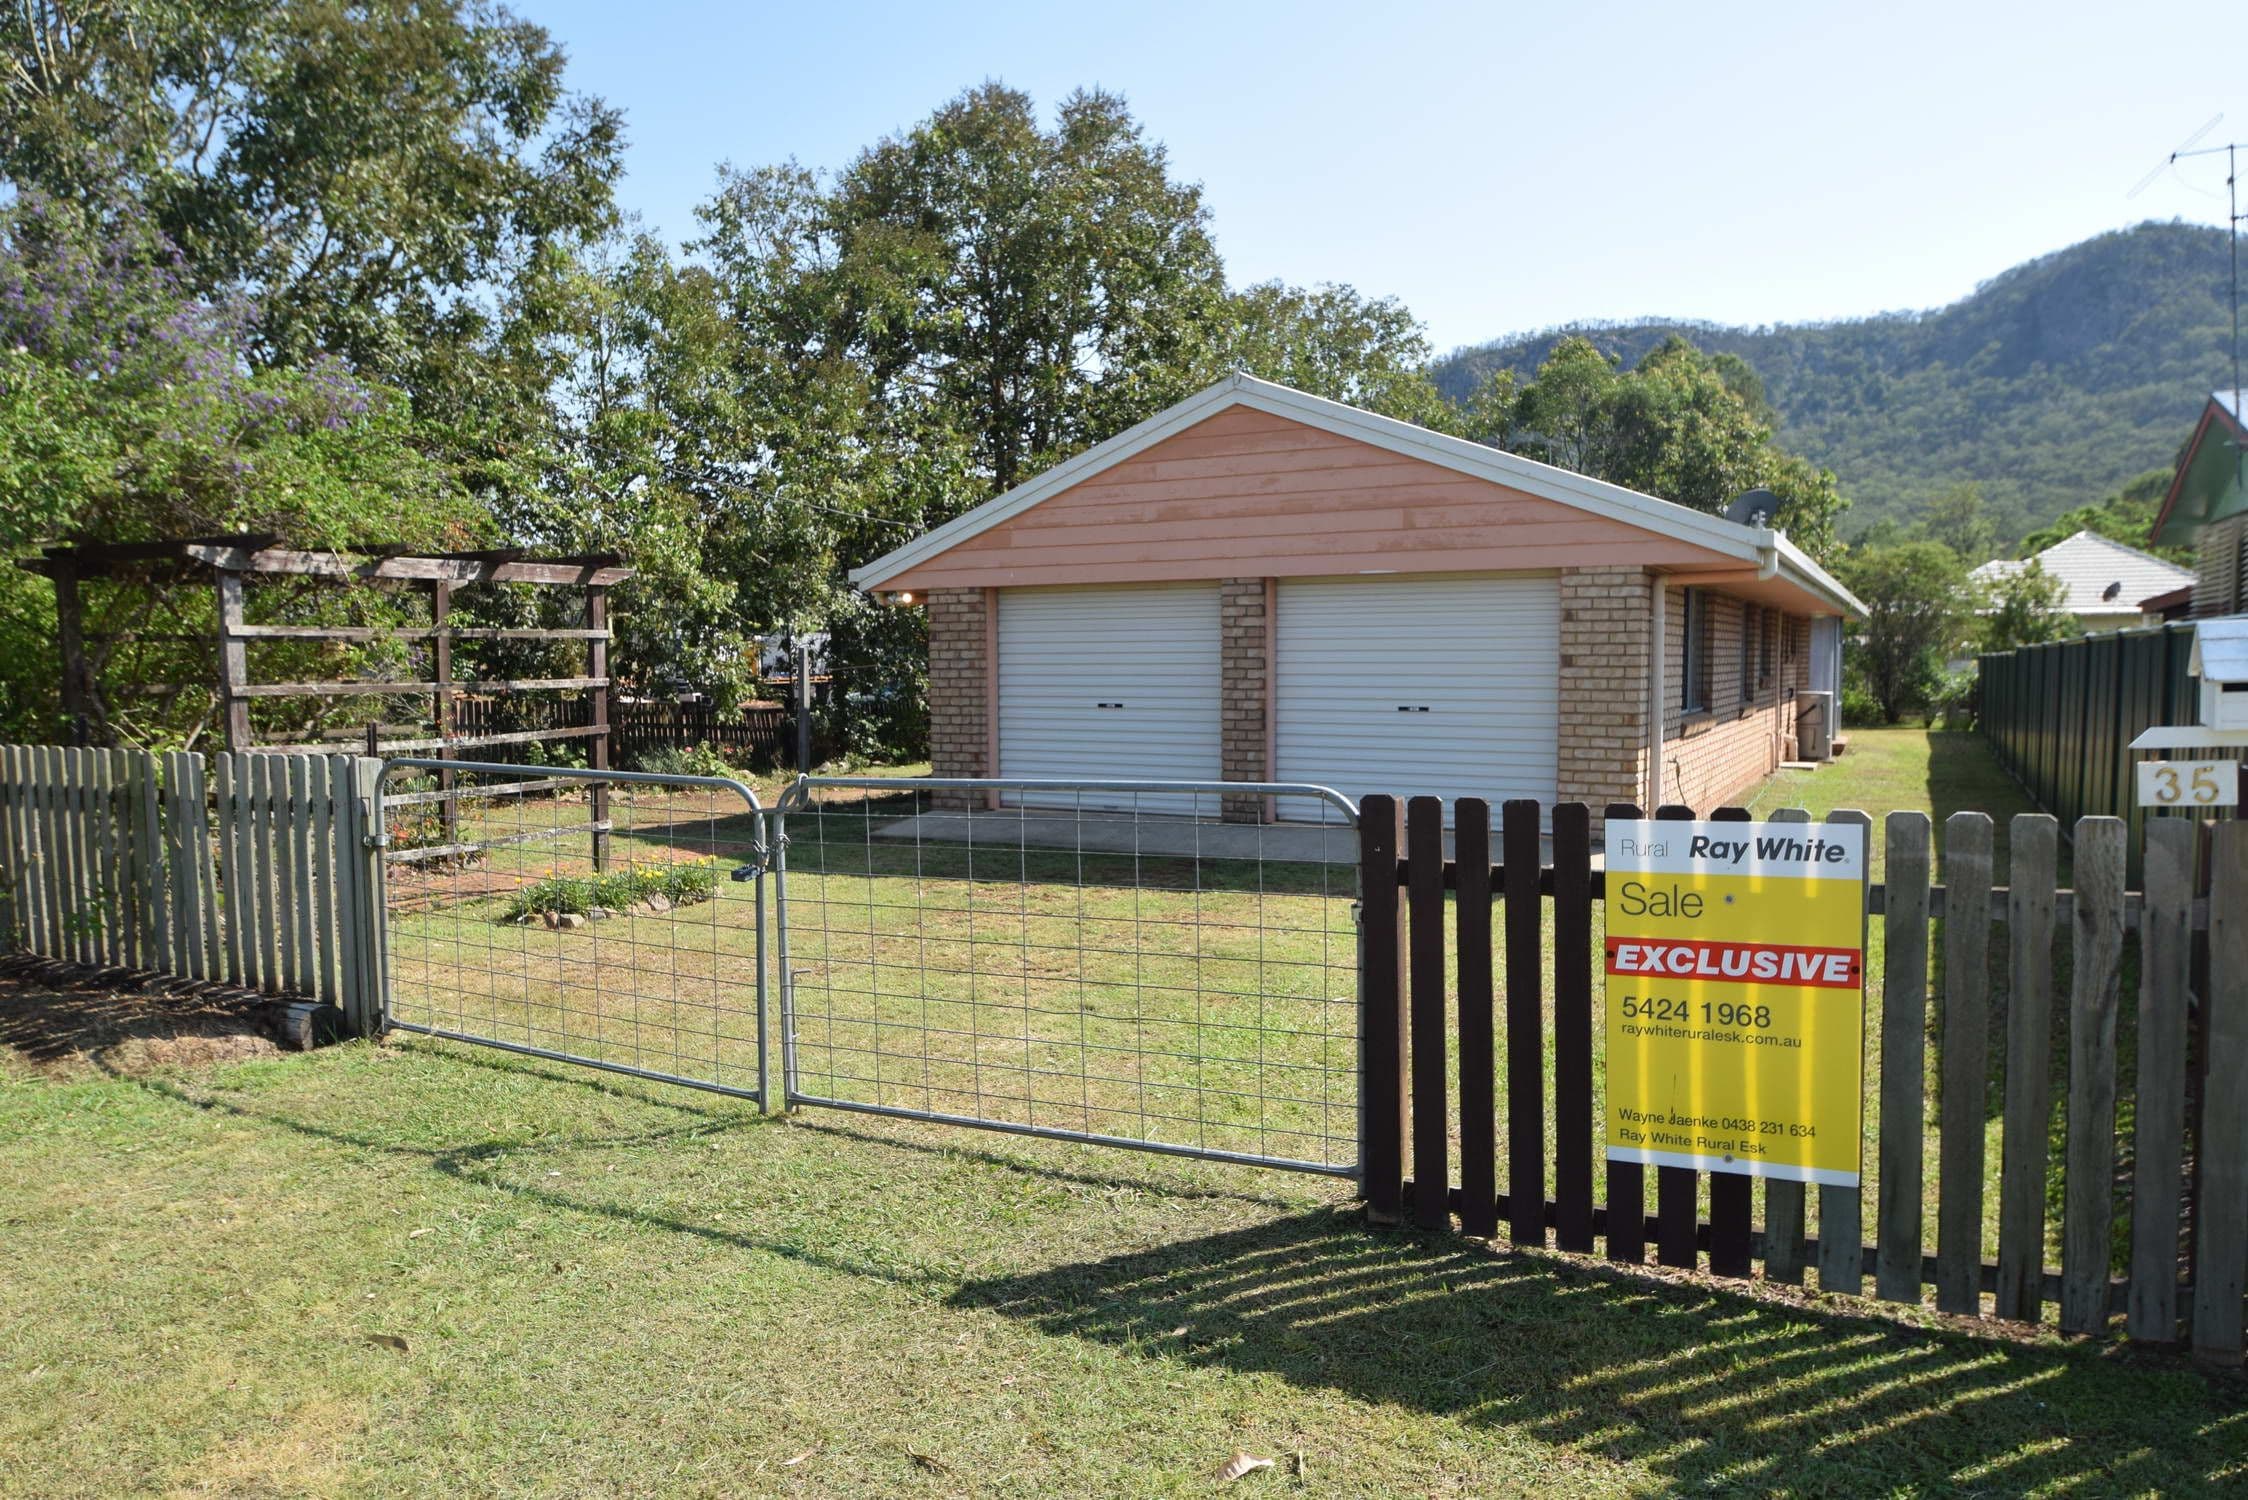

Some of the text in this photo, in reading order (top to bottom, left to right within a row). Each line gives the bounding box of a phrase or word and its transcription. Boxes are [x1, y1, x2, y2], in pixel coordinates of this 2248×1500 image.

[2155, 766, 2219, 803] 35
[1620, 838, 1669, 857] Rural
[1689, 835, 1750, 865] Ray
[1620, 881, 1704, 919] Sale
[1615, 944, 1851, 982] EXCLUSIVE
[1622, 996, 1771, 1028] 5424 1968
[1621, 1023, 1802, 1048] raywhiteruralesk.com.au
[1618, 1107, 1816, 1138] Wayne Jaenke 0438 231 634
[1620, 1128, 1767, 1155] Ray White Rural Esk
